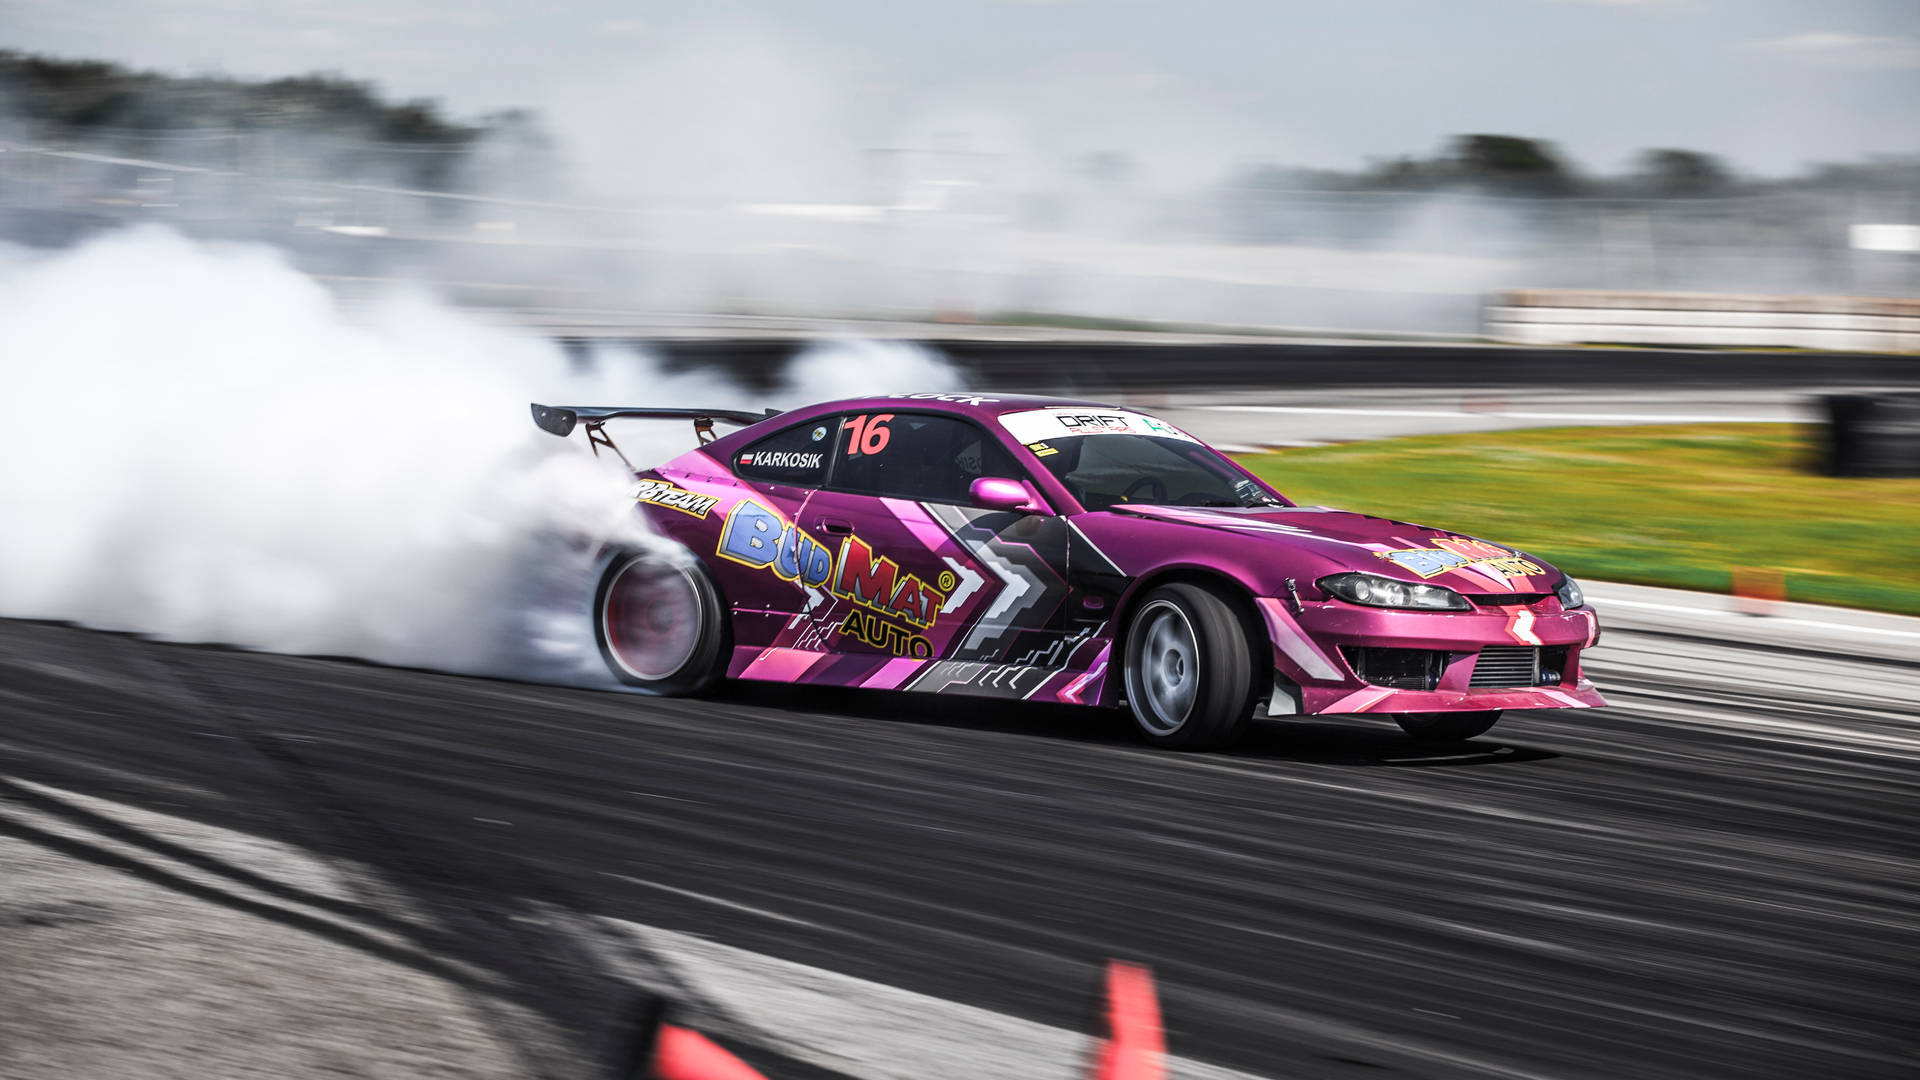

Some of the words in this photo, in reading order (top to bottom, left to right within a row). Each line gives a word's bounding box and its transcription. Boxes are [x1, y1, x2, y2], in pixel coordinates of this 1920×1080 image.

[844, 414, 895, 455] 16
[1056, 415, 1129, 427] DRIFT
[753, 451, 824, 469] KARKOSIK
[838, 609, 935, 661] AUTO
